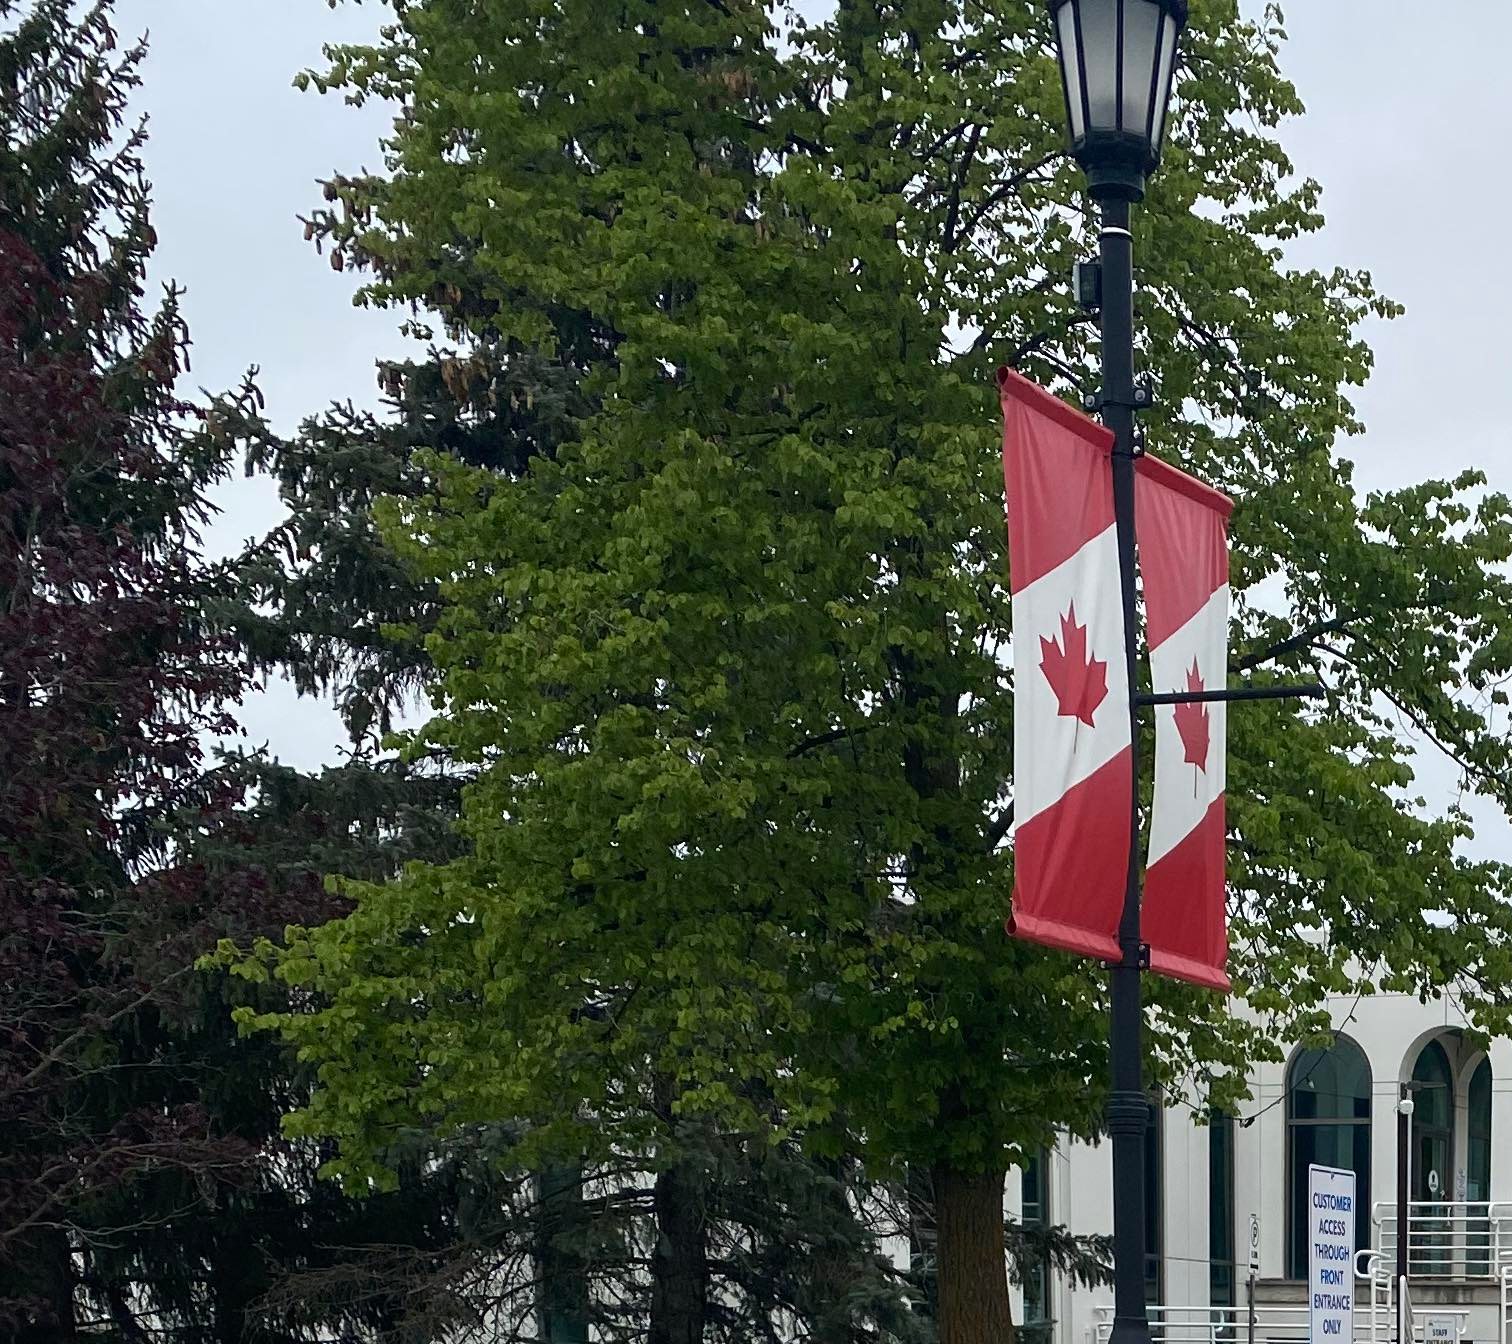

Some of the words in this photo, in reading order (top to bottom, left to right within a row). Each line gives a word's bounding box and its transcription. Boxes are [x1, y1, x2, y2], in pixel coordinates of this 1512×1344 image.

[1313, 1192, 1351, 1212] CUSTOMER
[1319, 1219, 1345, 1236] ACCESS
[1315, 1244, 1349, 1261] THROUGH
[1320, 1269, 1344, 1285] FRONT
[1314, 1294, 1350, 1310] ENTRANCE
[1323, 1319, 1341, 1334] ONLY
